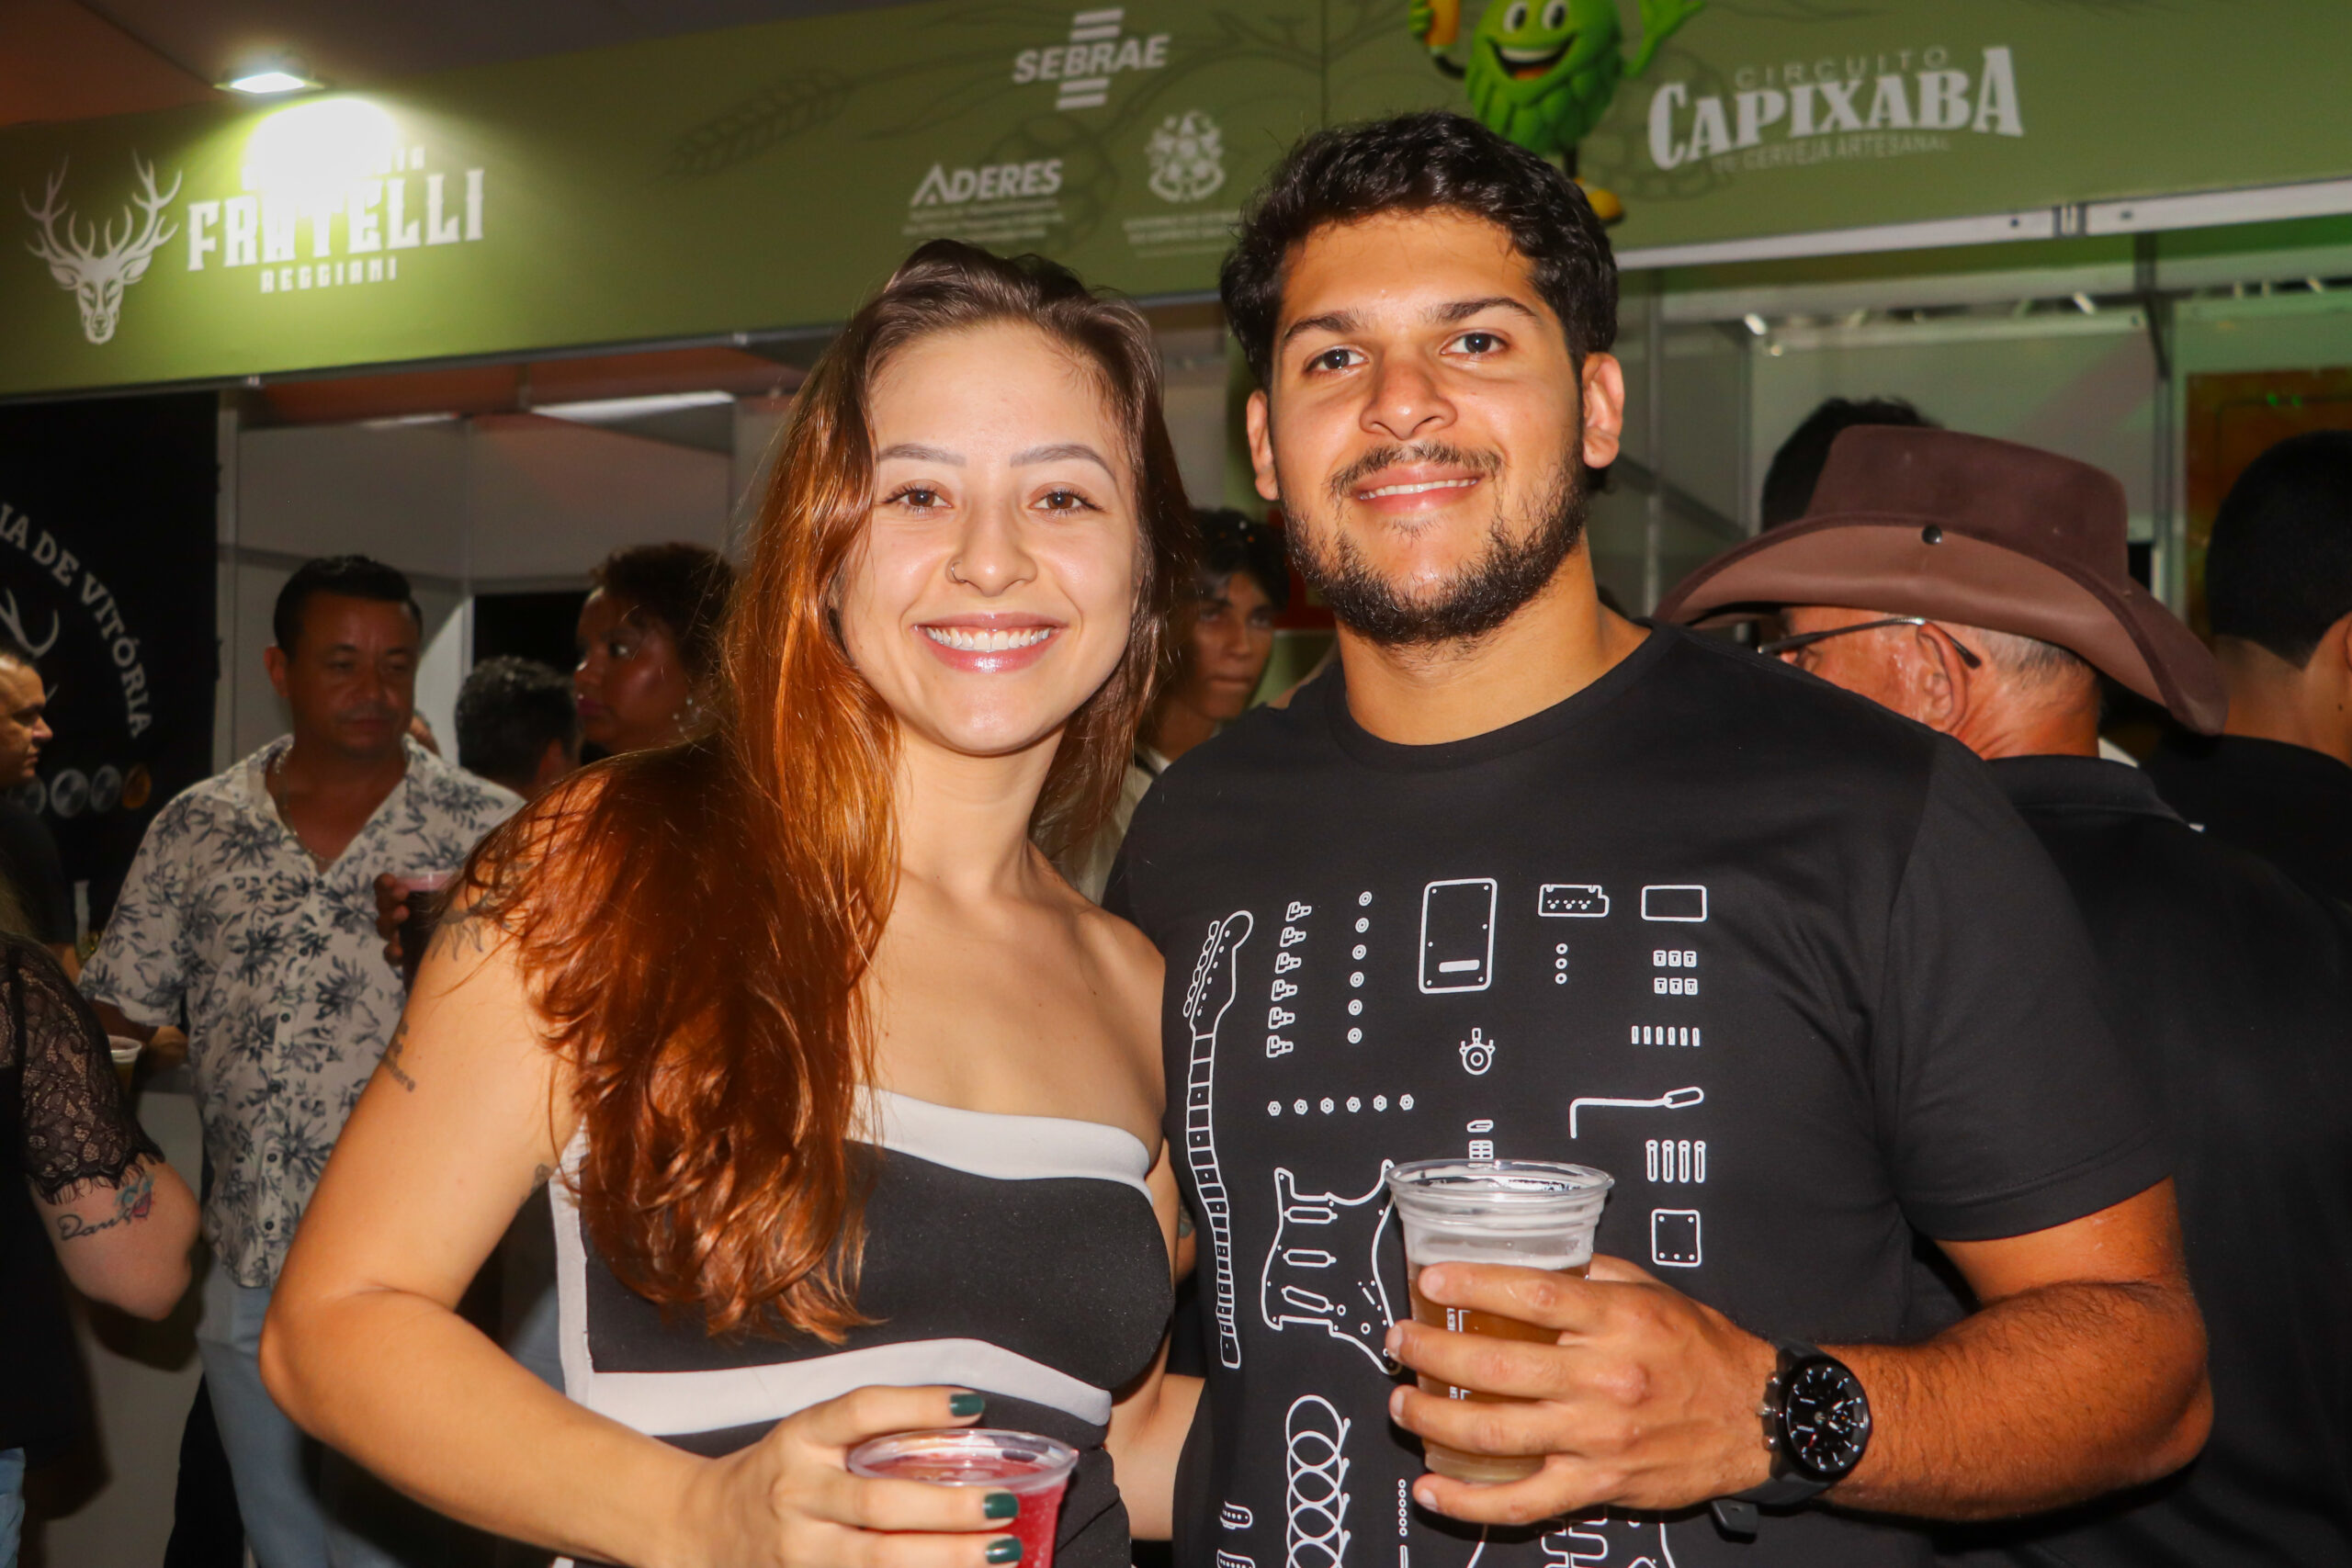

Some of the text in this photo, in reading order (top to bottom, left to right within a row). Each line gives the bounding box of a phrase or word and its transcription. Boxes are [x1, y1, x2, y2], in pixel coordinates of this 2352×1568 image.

[1012, 34, 1171, 84] SEBRAE
[1735, 45, 1949, 88] CIRCUITO
[1647, 45, 2023, 170] CAPIXABA
[187, 167, 484, 271] FRATELLI
[910, 159, 1062, 208] ADERES
[32, 529, 80, 588] DE
[81, 570, 153, 739] VITÓRIA
